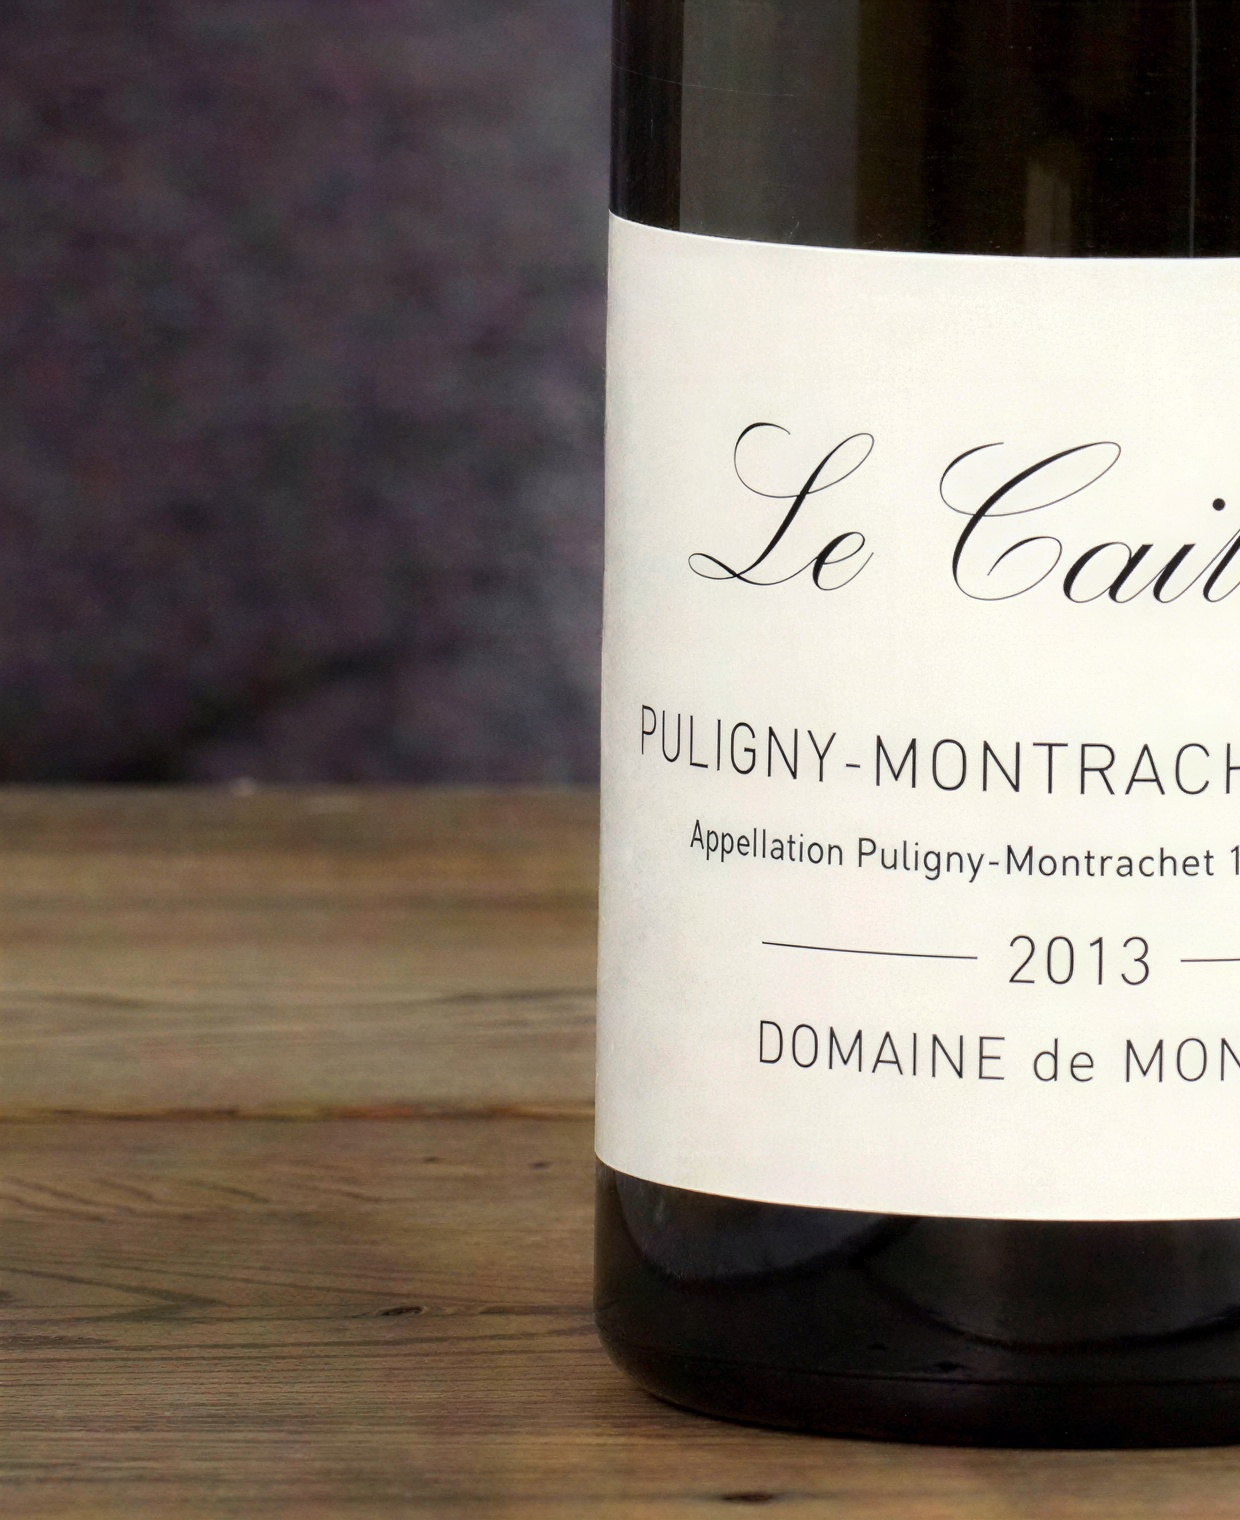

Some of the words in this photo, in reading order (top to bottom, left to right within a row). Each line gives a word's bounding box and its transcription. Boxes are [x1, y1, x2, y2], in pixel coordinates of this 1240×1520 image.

[688, 422, 875, 591] Le
[689, 819, 843, 866] Appellation
[858, 837, 1214, 883] Puligny-Montrachet
[1008, 935, 1150, 986] 2013
[759, 1019, 1005, 1081] DOMAINE
[1033, 1038, 1094, 1083] de
